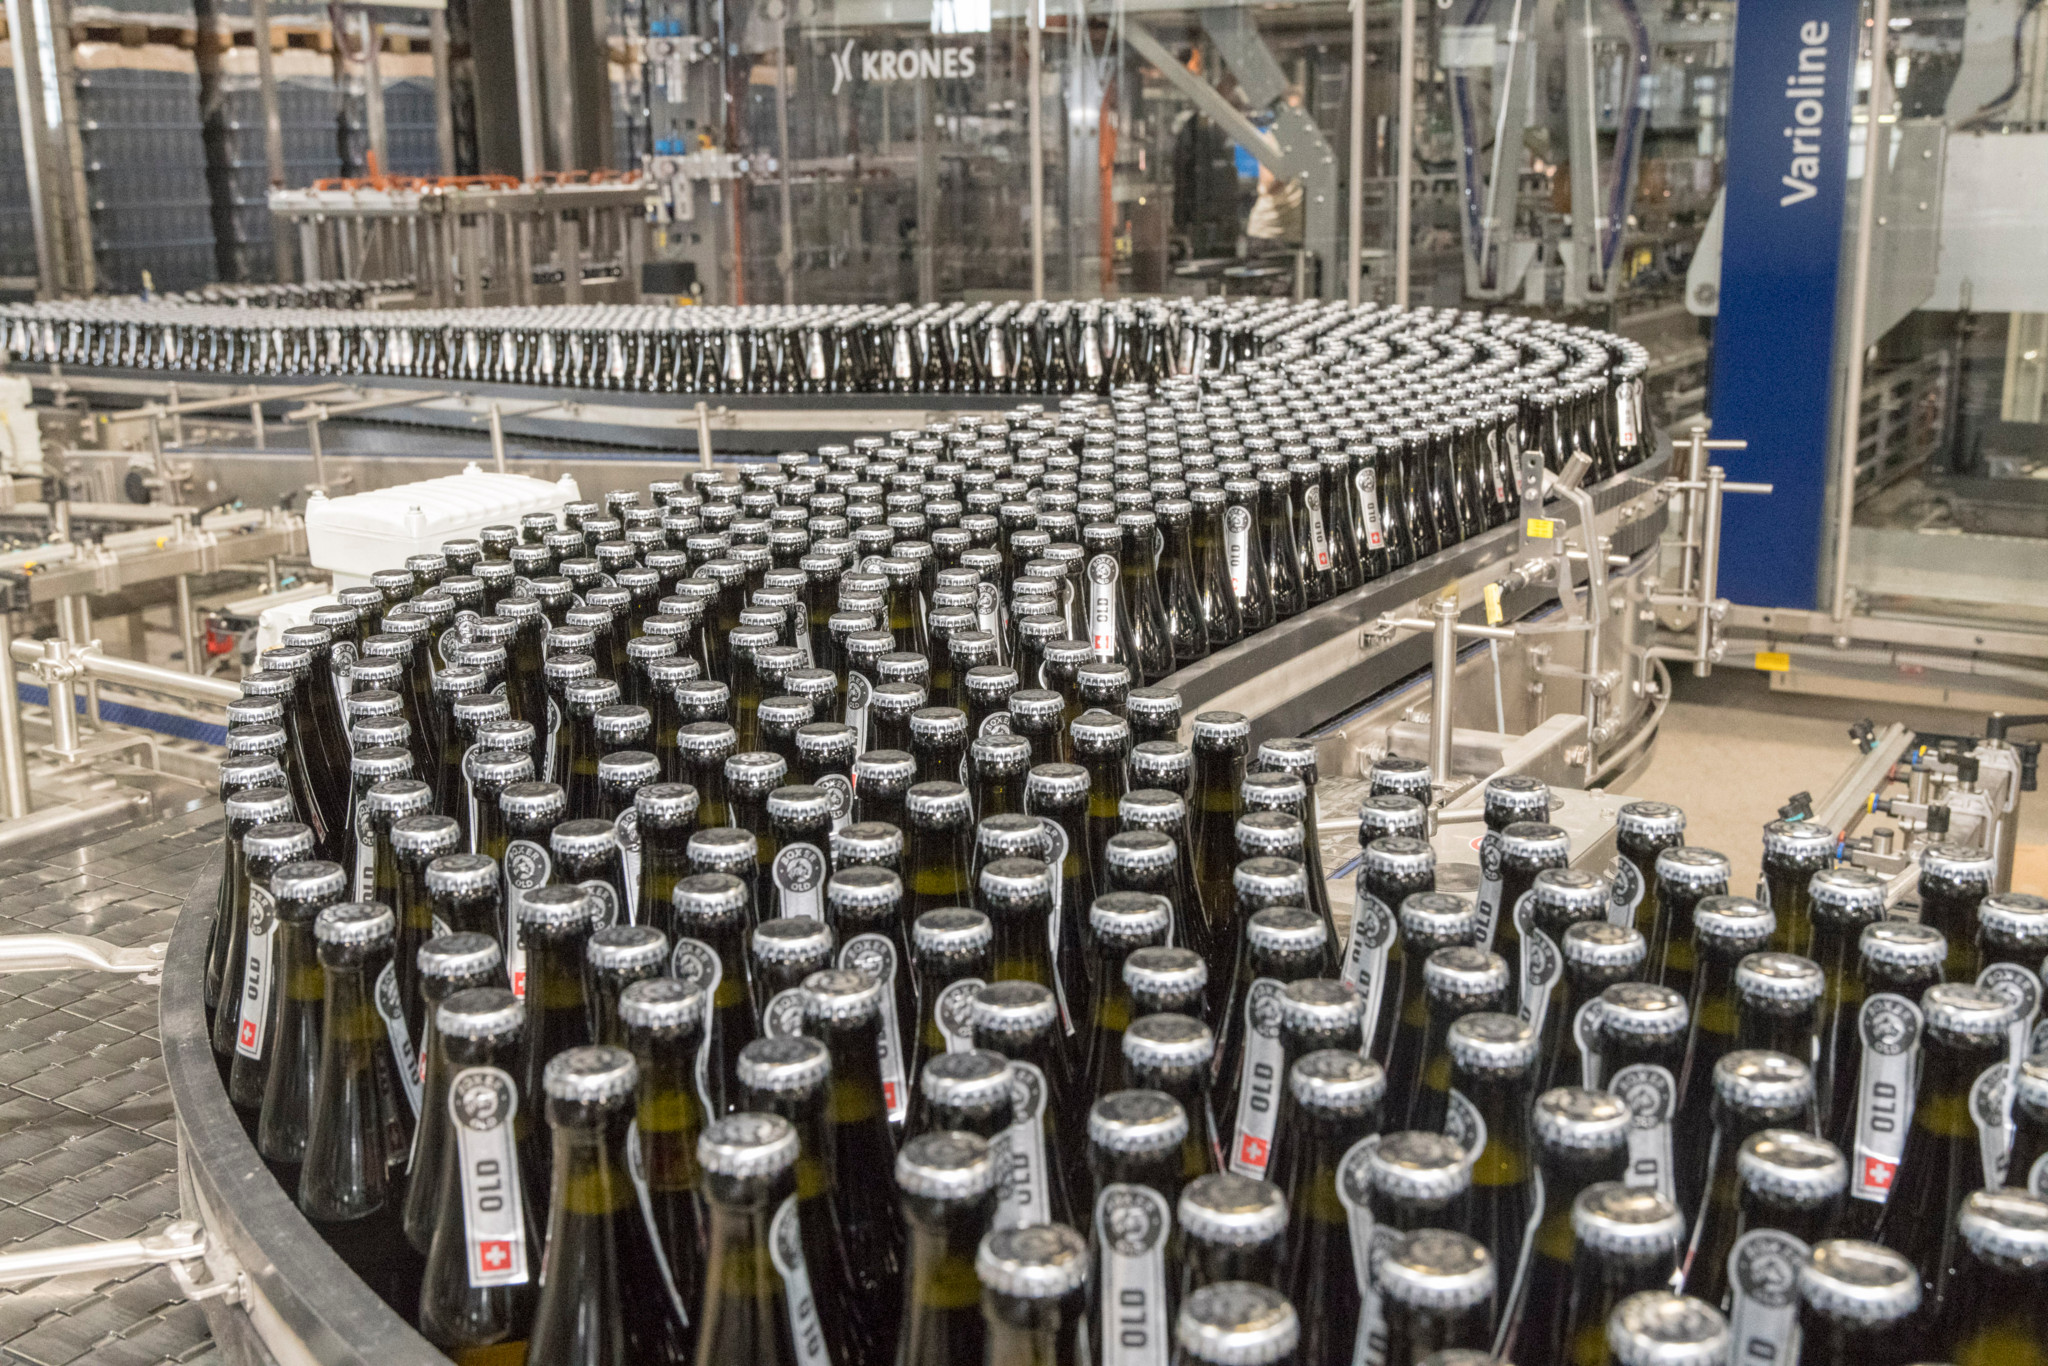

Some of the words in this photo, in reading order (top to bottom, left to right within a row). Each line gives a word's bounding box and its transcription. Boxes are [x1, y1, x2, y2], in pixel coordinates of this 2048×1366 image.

[862, 46, 976, 81] KRONES
[1780, 20, 1830, 207] Varioline
[1096, 598, 1109, 623] OLD
[985, 716, 1011, 731] BOXE
[509, 846, 539, 862] BOXER
[781, 849, 817, 866] BOXER
[514, 878, 533, 889] OLD
[790, 881, 812, 891] OLD
[1475, 900, 1492, 943] OLD
[248, 957, 260, 1001] OLD
[1251, 1062, 1273, 1113] OLD
[1871, 1081, 1897, 1134] OLD
[476, 1159, 504, 1212] OLD
[1120, 1289, 1147, 1347] OLD
